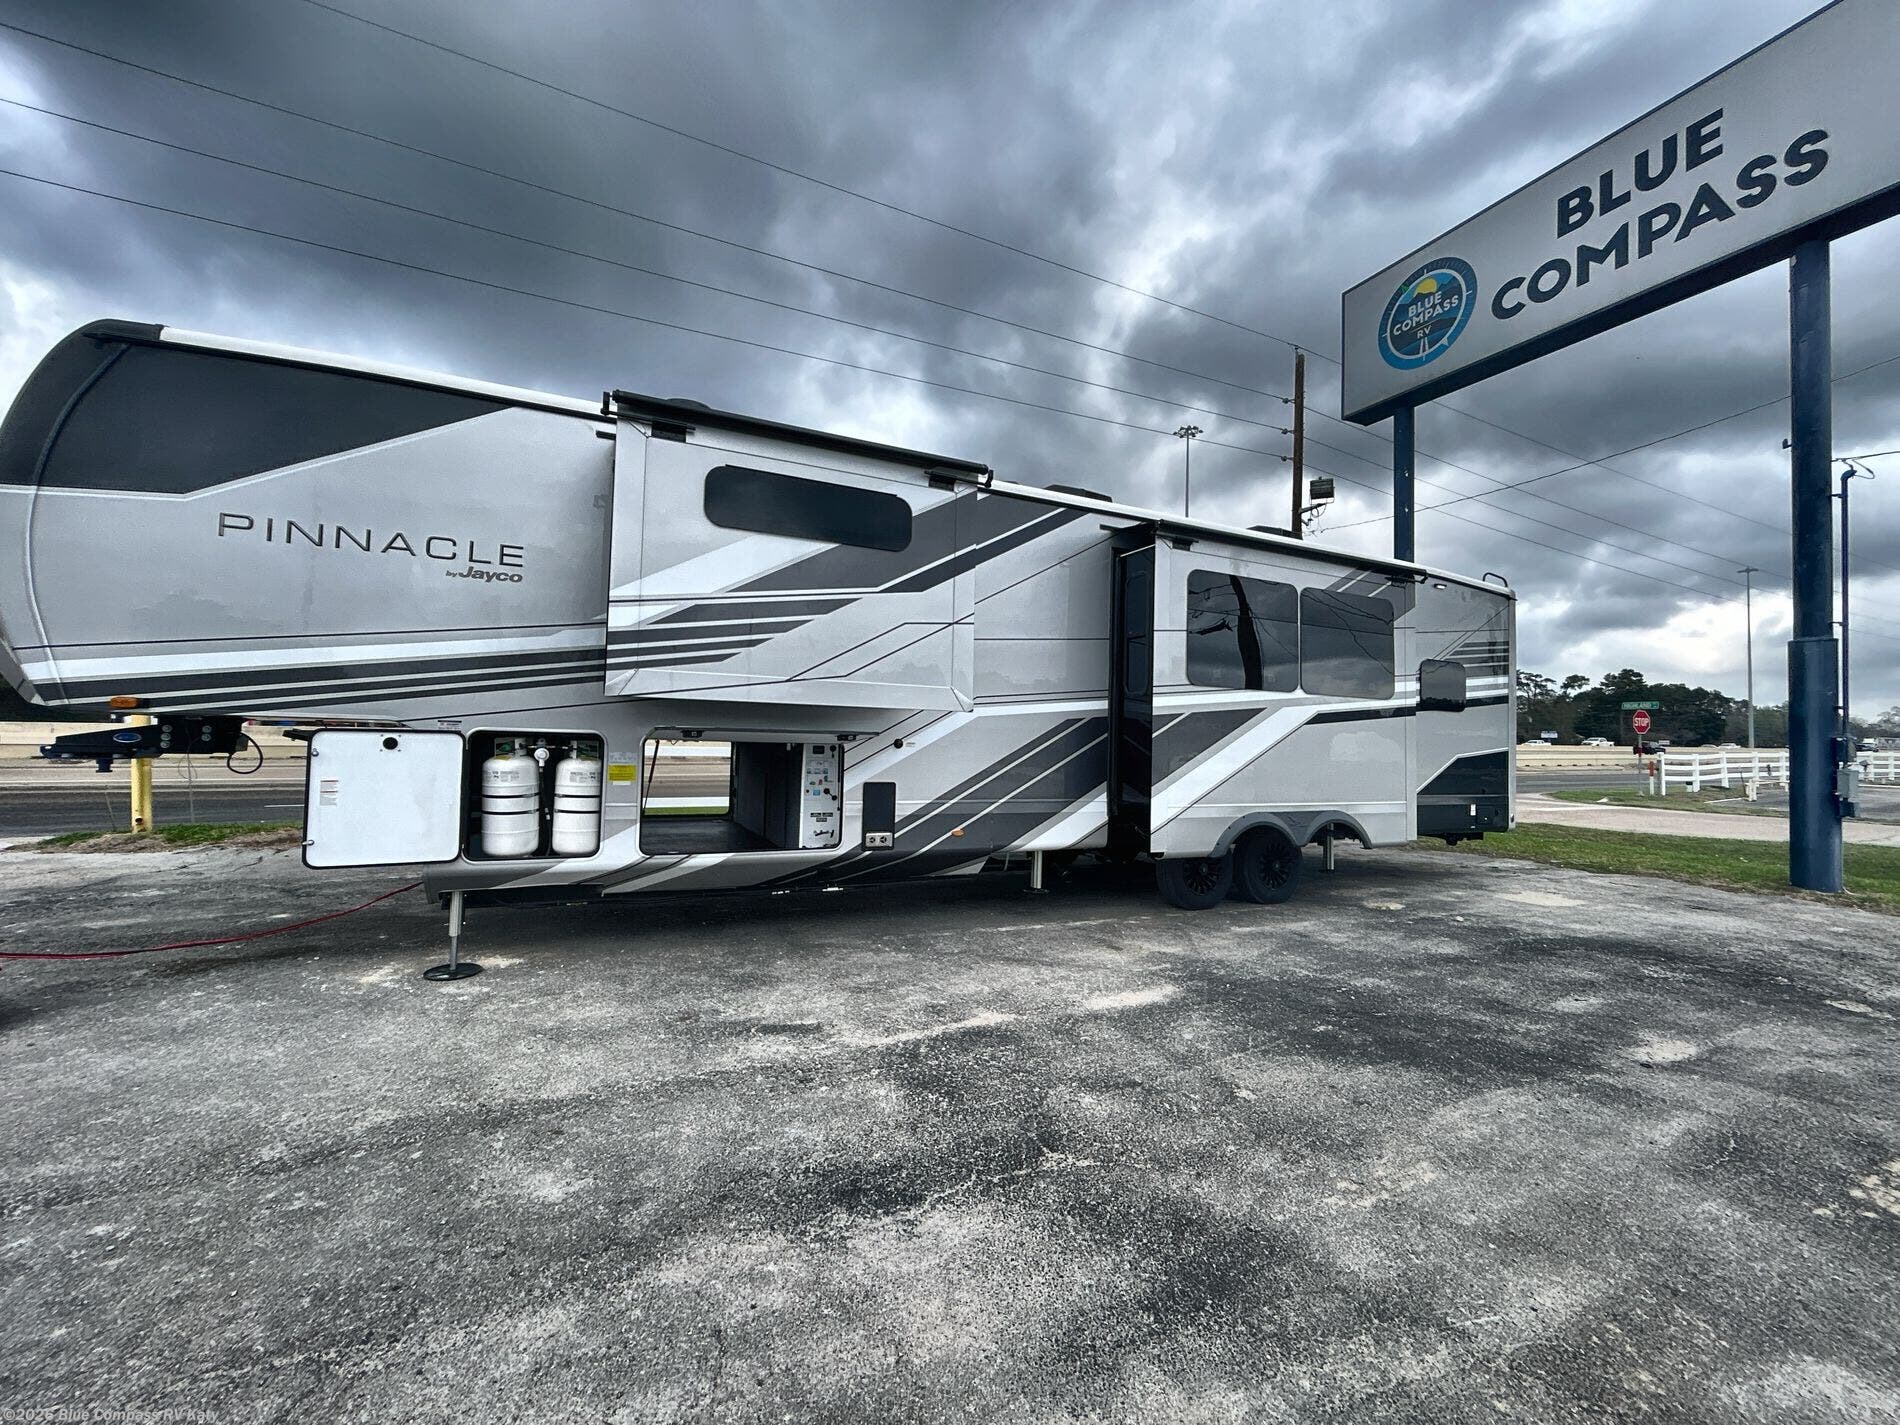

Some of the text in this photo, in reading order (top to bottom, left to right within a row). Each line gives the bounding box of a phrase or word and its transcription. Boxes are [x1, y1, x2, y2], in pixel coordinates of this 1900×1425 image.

[1557, 107, 1723, 239] BLUE
[1491, 129, 1829, 319] COMPASS
[1393, 295, 1459, 336] COMPASS
[1408, 291, 1442, 317] BLUE
[1417, 325, 1432, 339] RV
[218, 512, 524, 567] PINNACLE
[445, 566, 523, 583] by Jayco
[1634, 717, 1649, 727] STOP
